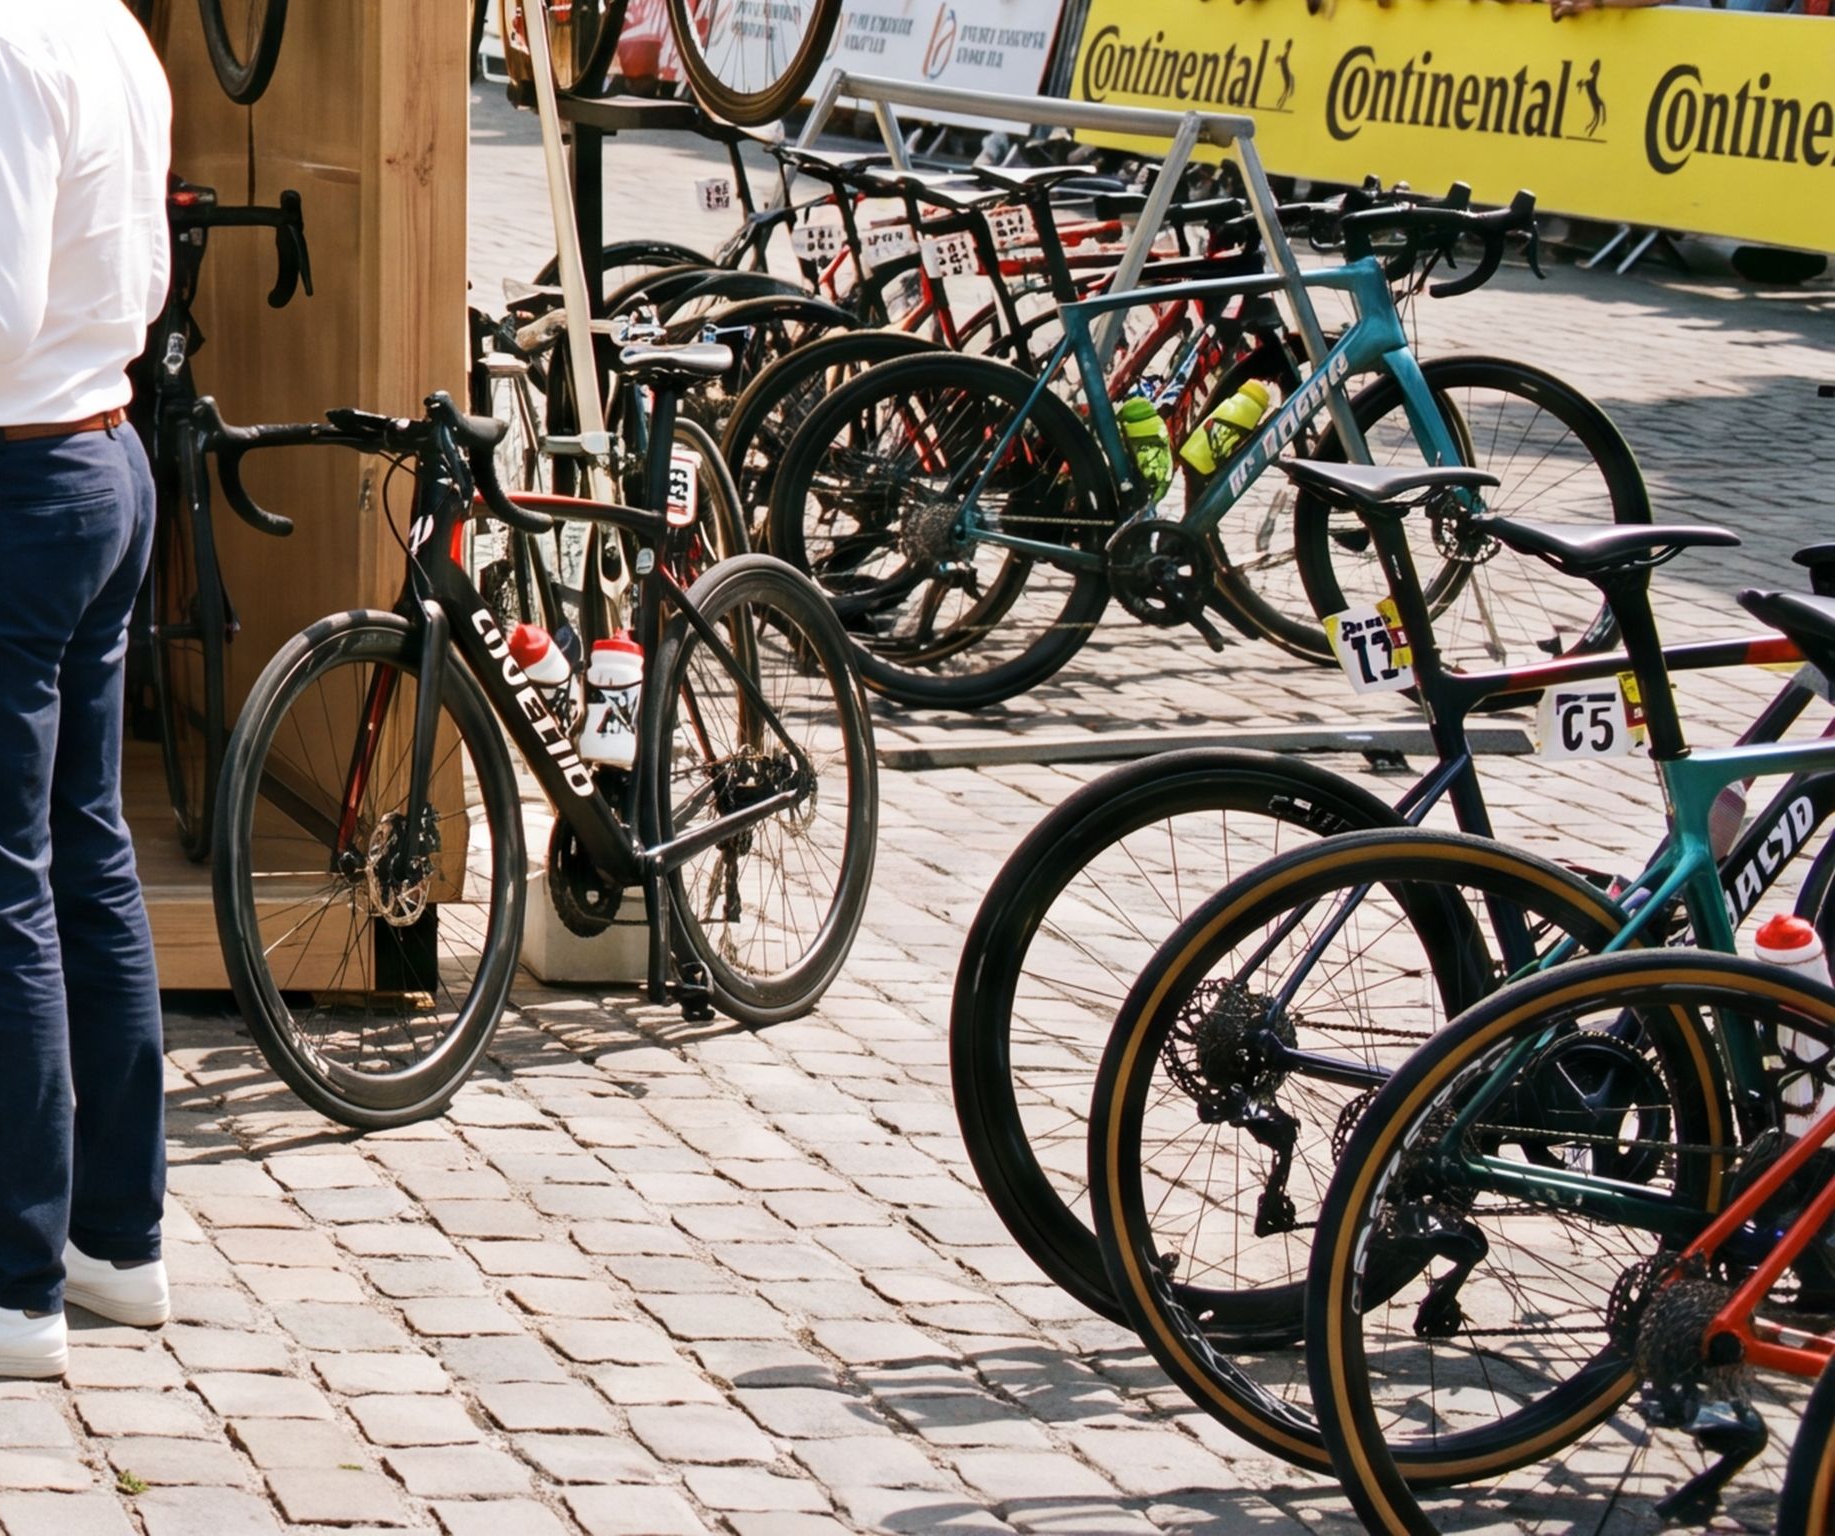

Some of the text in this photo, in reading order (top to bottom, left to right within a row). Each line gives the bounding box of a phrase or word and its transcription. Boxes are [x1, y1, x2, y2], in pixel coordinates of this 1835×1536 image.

[1082, 24, 1271, 109] Continental
[1326, 45, 1572, 141] Continental
[1645, 64, 1835, 175] Contine
